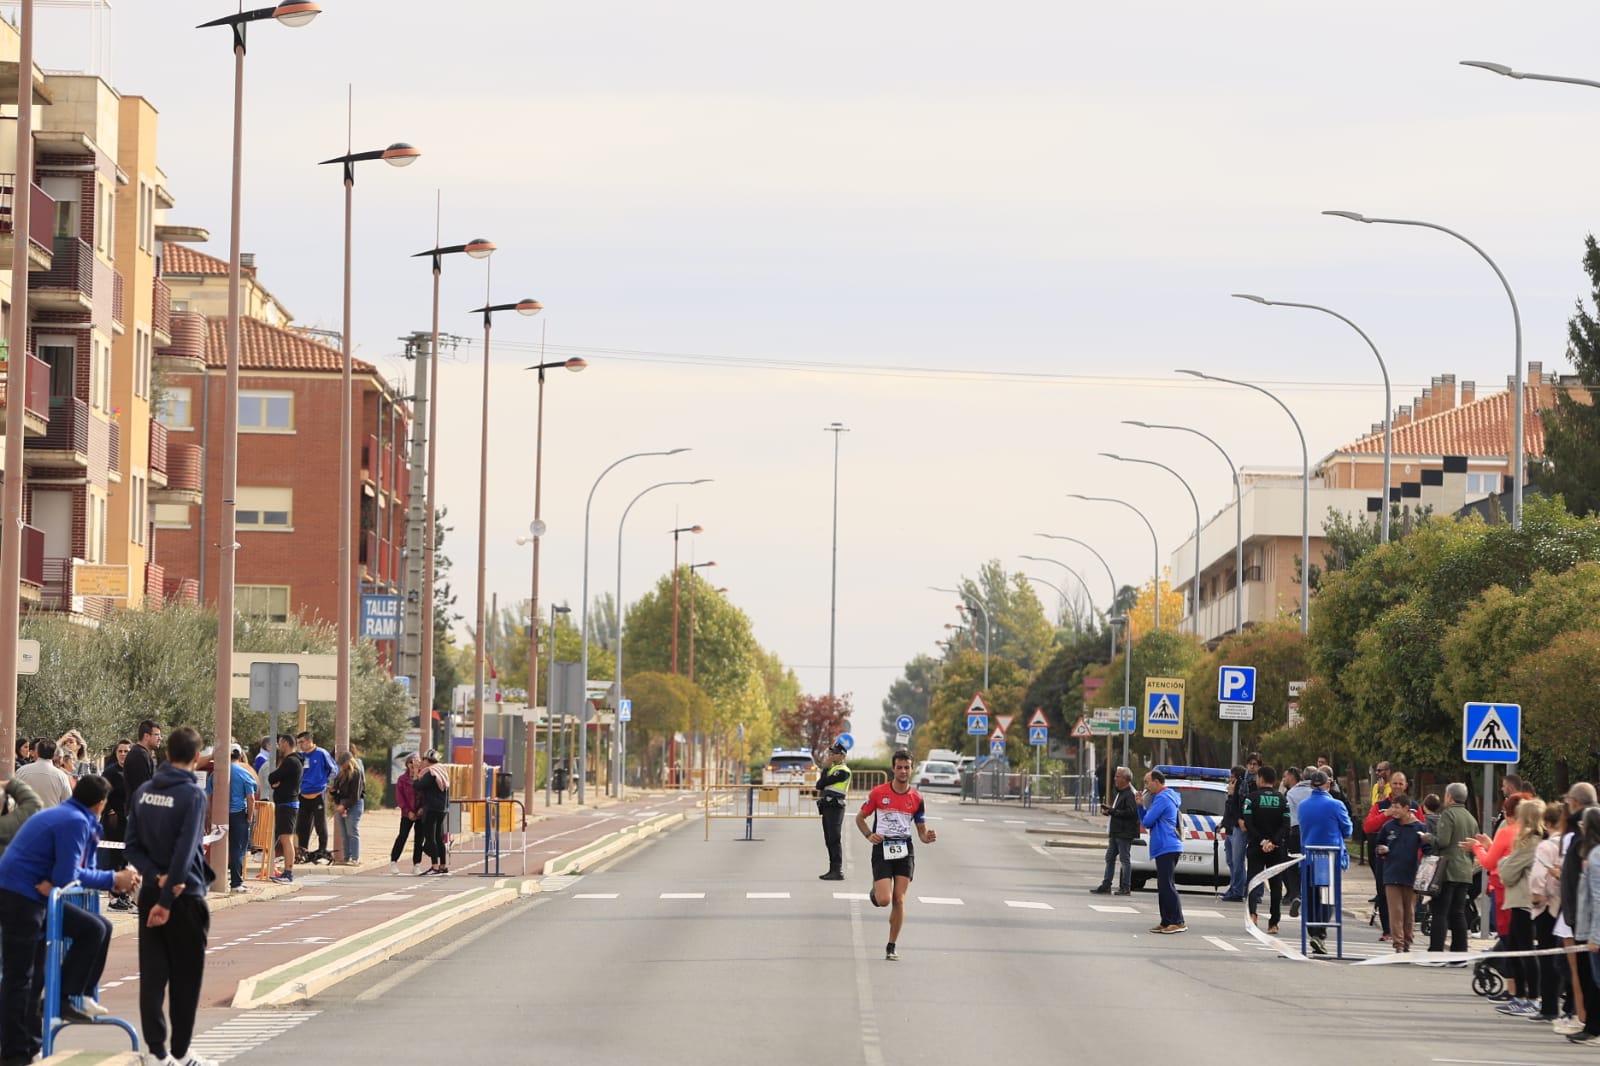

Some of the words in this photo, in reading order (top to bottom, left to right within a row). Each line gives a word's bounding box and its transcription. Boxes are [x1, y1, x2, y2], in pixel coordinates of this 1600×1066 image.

[1147, 681, 1184, 689] ATENCIÓN
[1223, 670, 1246, 698] P
[1259, 795, 1280, 807] AVS
[889, 846, 902, 854] 63
